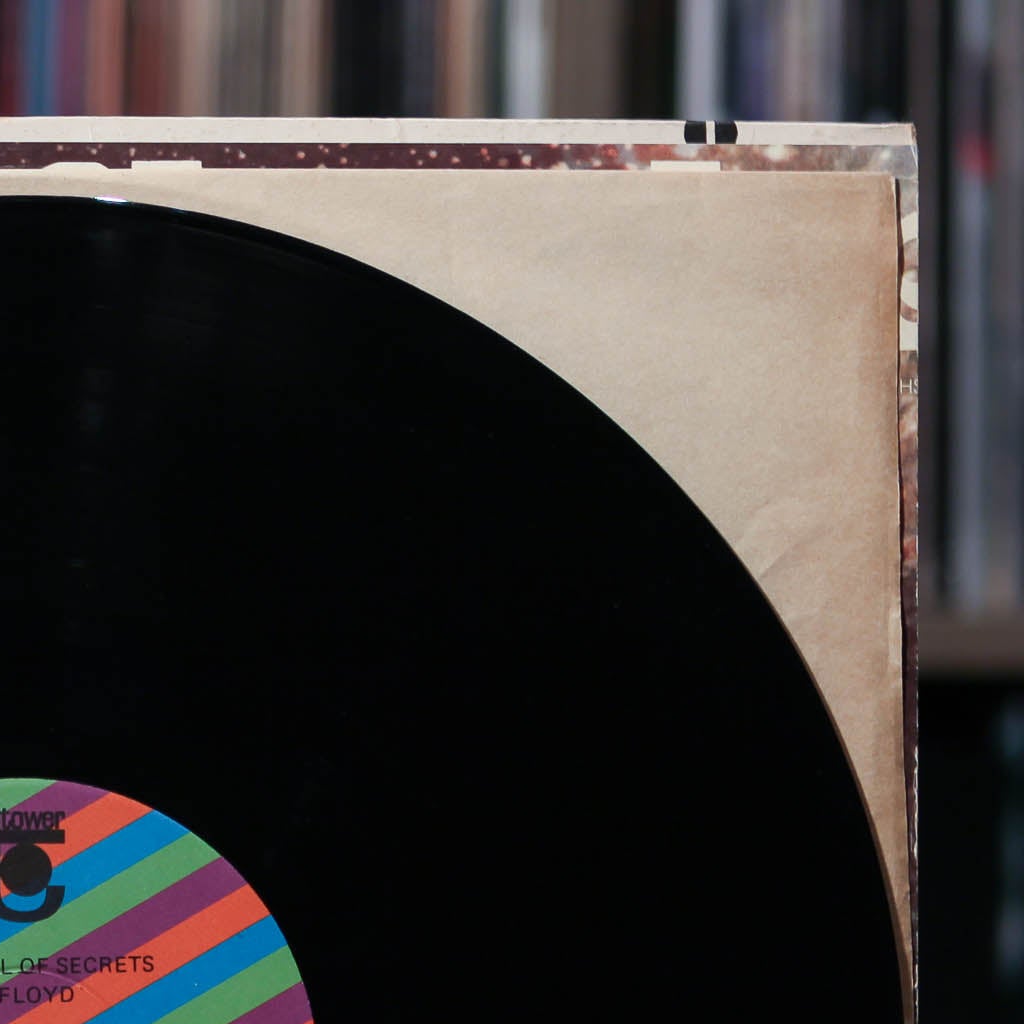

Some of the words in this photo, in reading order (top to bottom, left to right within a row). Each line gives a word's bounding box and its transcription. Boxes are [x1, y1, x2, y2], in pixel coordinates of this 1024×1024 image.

[0, 808, 66, 831] tower
[19, 957, 48, 974] OF
[56, 956, 155, 974] SECRETS
[0, 986, 75, 1004] FLOYD
